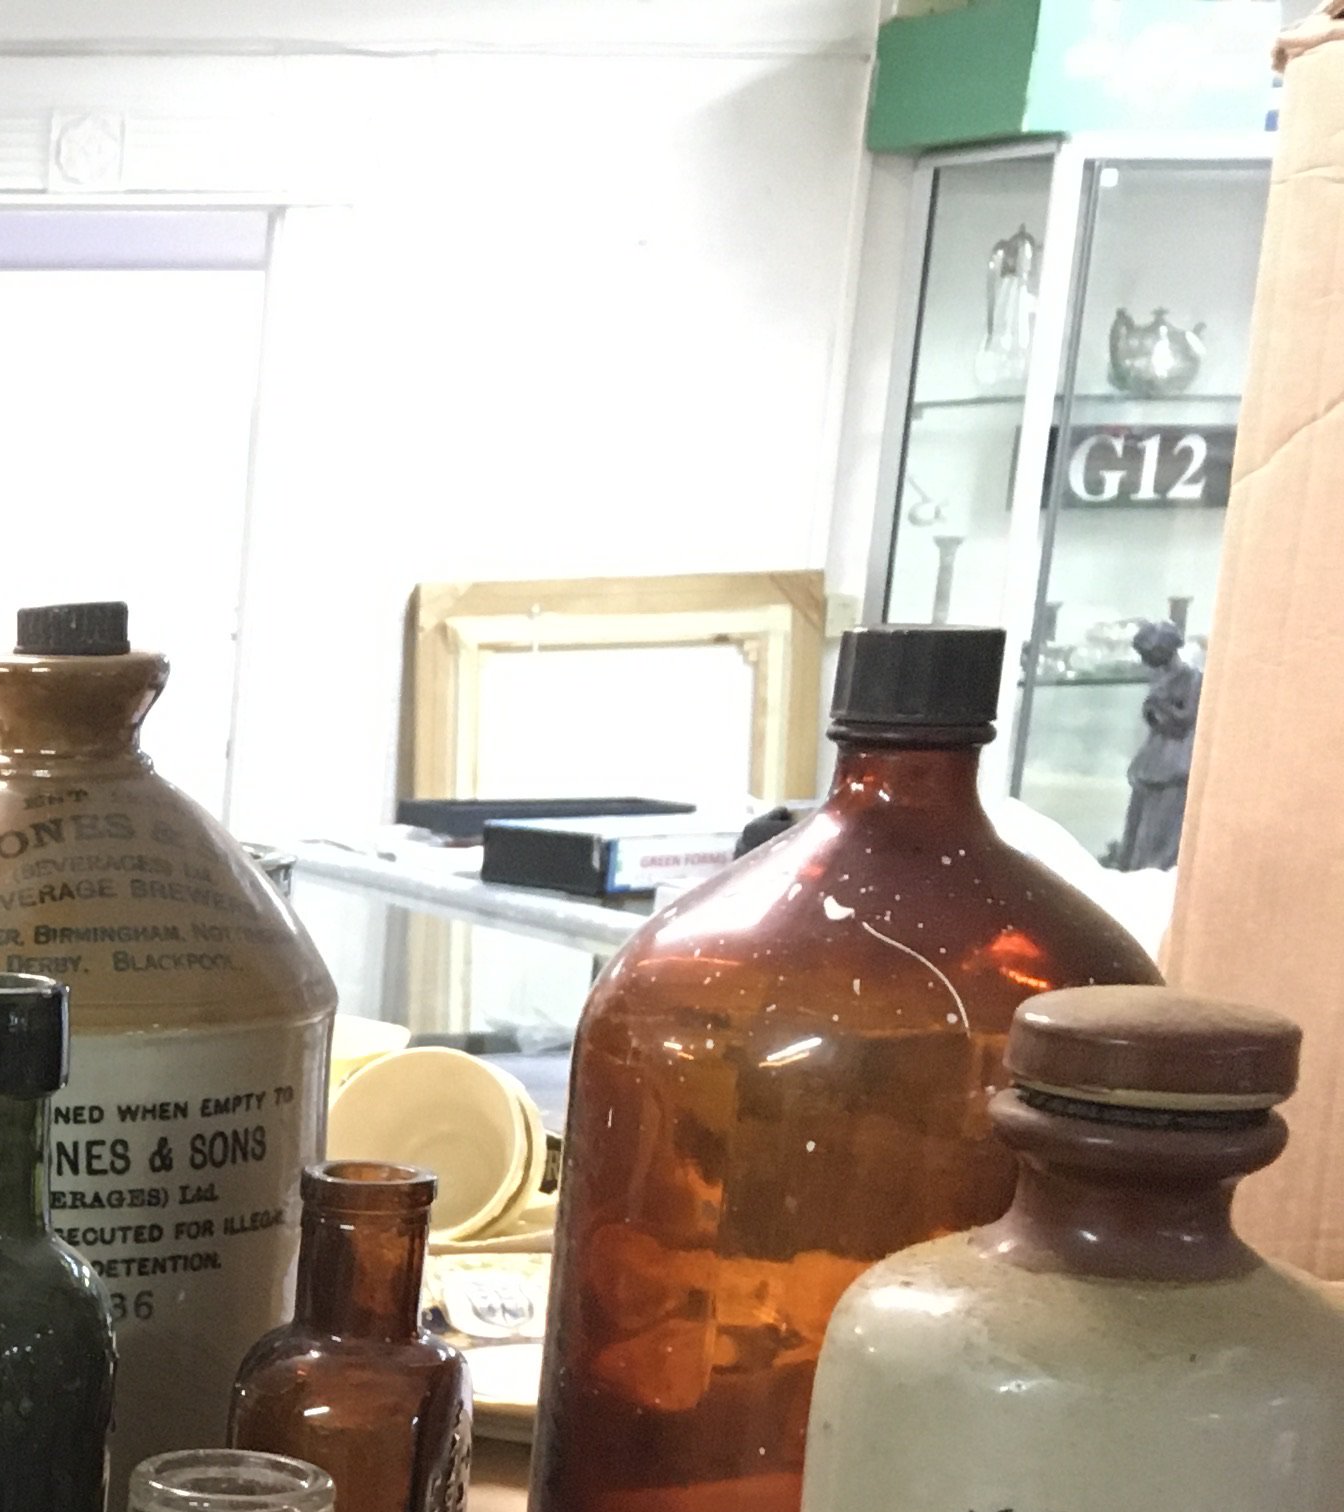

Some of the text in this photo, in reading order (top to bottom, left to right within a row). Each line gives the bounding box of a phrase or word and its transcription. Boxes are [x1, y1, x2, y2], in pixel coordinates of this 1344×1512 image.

[1068, 433, 1208, 503] G12
[118, 1101, 188, 1123] WHEN
[200, 1092, 266, 1117] EMPTY
[275, 1086, 294, 1105] TO
[149, 1137, 174, 1172] &
[190, 1126, 266, 1170] SONS
[175, 1219, 214, 1240] FOR
